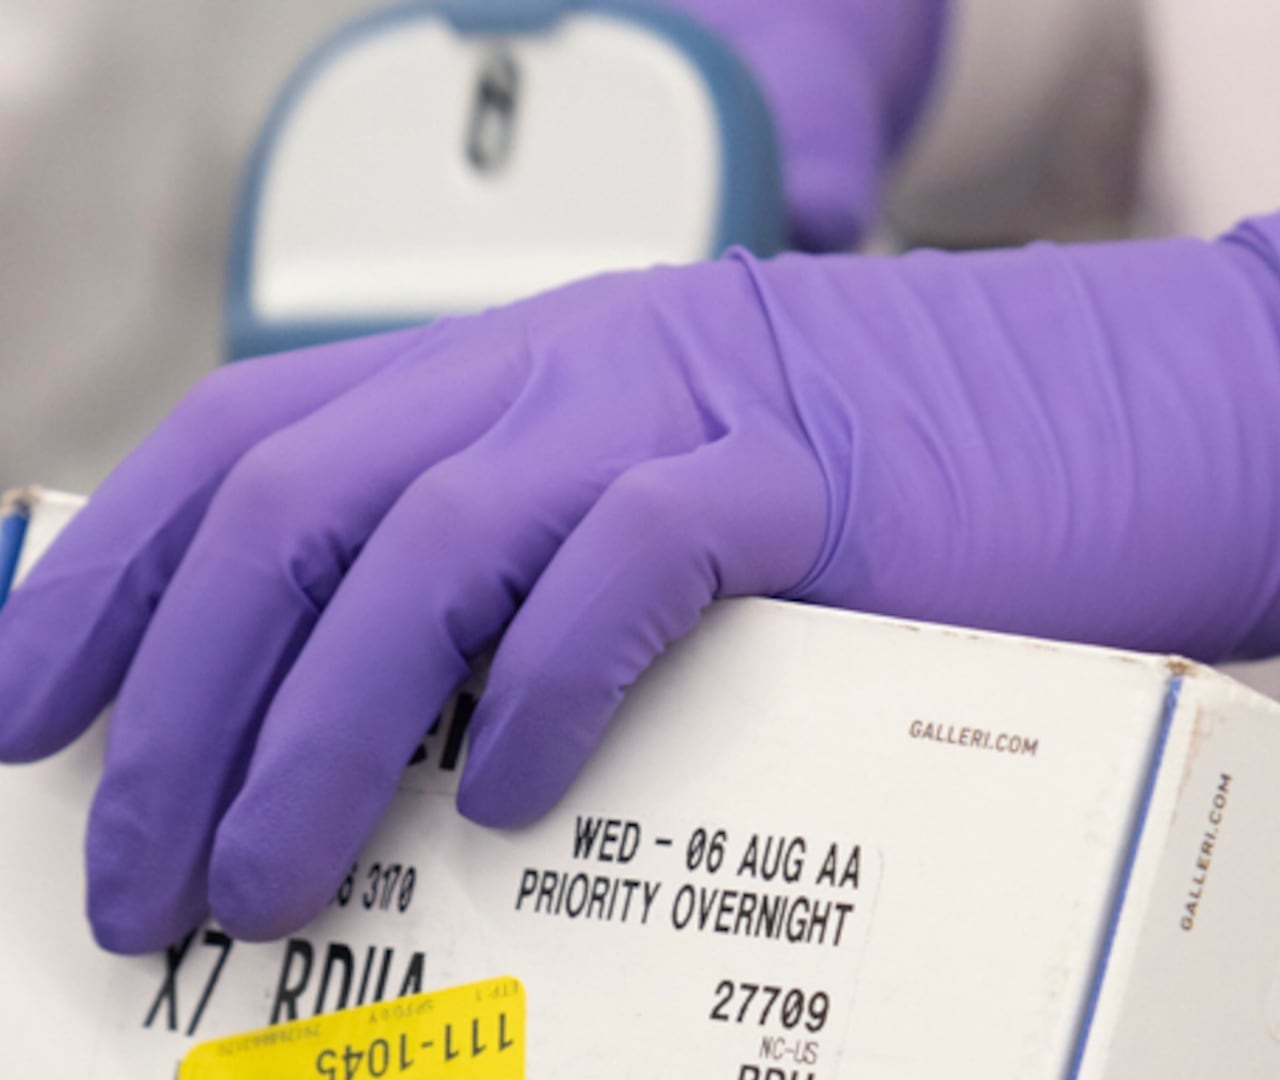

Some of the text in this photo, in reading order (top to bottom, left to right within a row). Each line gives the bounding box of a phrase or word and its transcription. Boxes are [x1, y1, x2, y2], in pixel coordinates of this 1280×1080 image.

[908, 719, 1039, 756] GALLERI.COM
[572, 815, 641, 864] WED
[686, 827, 728, 873] 06
[737, 833, 807, 884] AUG
[816, 841, 862, 889] AA
[1180, 773, 1233, 932] GALLERI.COM
[362, 862, 417, 913] 3170
[514, 868, 855, 947] PRIORITY OVERNIGHT
[709, 979, 831, 1033] 27709
[759, 1036, 819, 1065] NC-US
